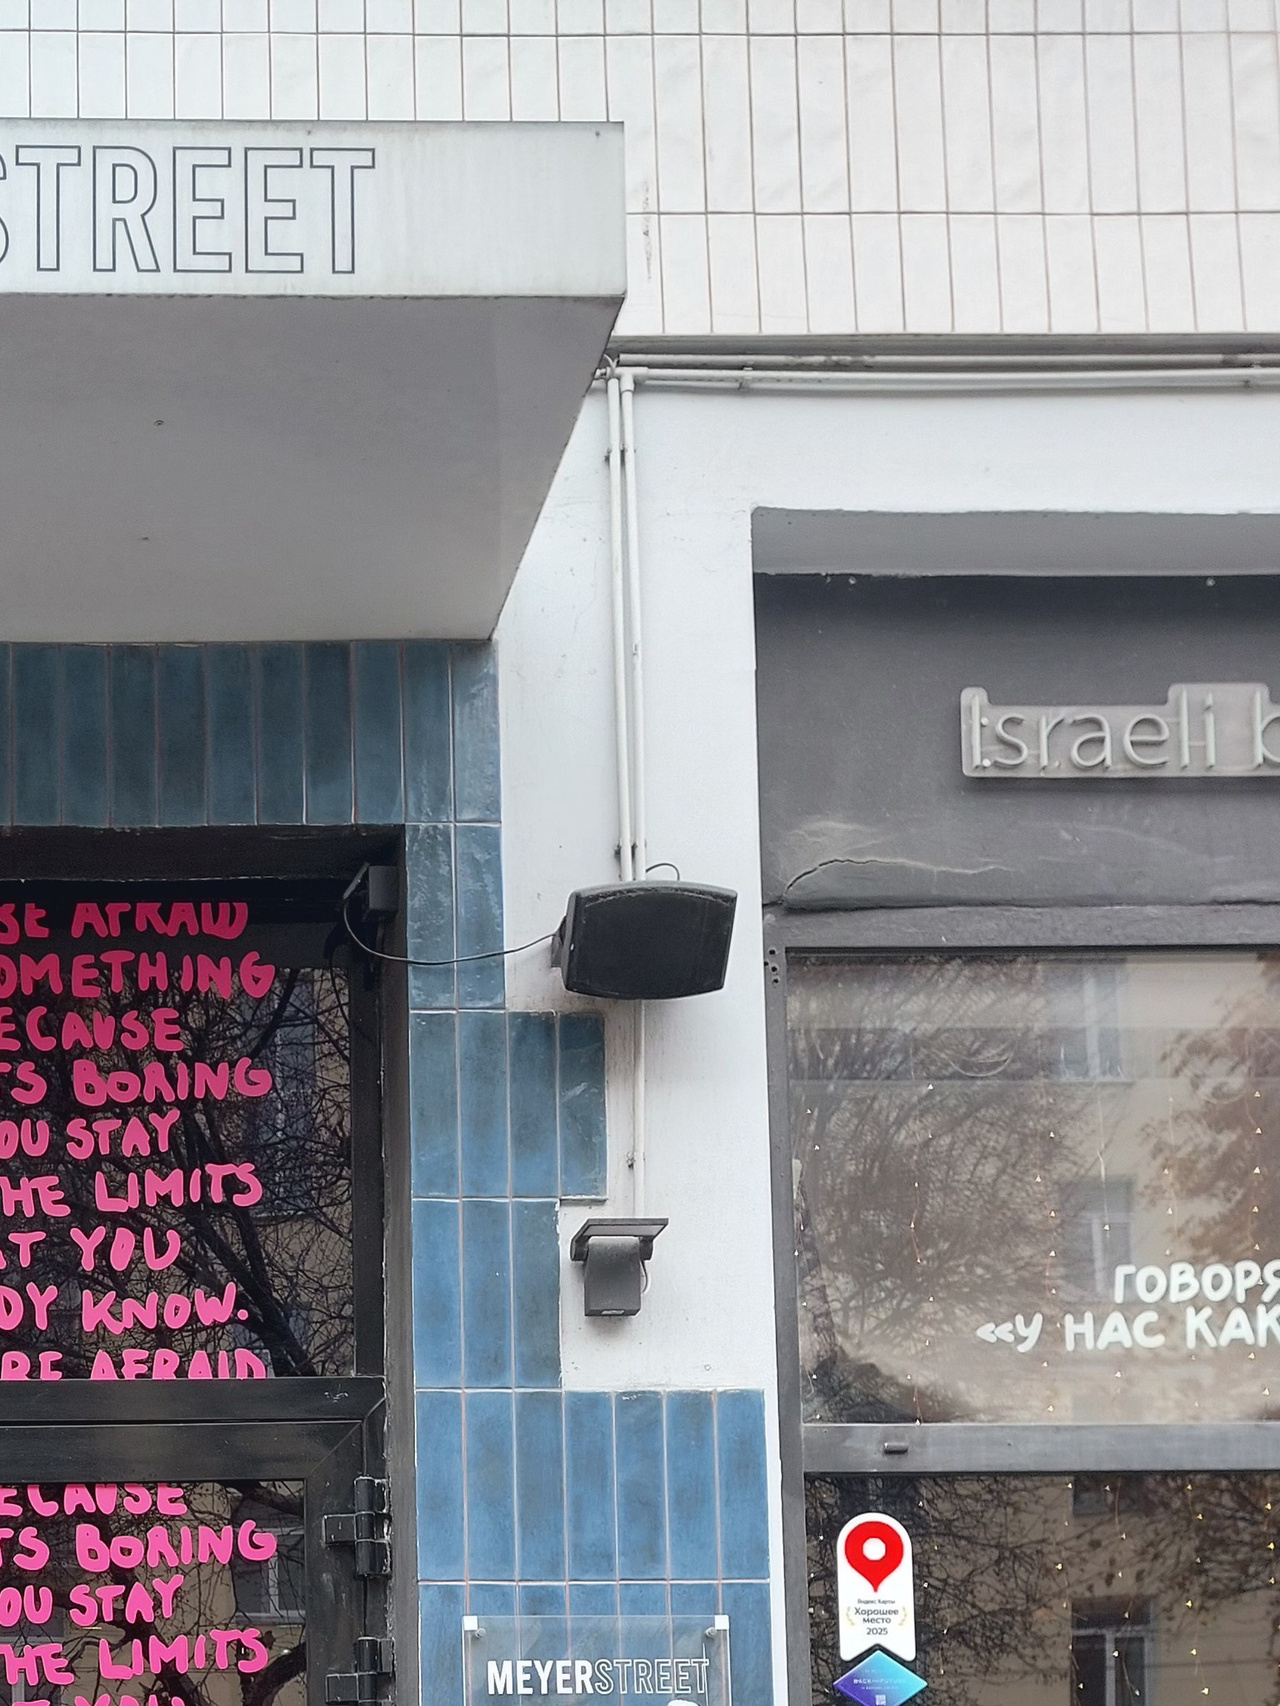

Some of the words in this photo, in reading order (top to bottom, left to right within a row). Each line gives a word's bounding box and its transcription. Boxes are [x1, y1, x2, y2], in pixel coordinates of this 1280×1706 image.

[970, 688, 1215, 770] Israeli
[72, 903, 247, 939] AFRAID
[74, 1057, 272, 1106] BORING
[67, 1109, 180, 1159] STAY
[95, 1163, 262, 1212] LIMITS
[71, 1226, 181, 1271] YOU
[1114, 1259, 1280, 1304] ГОВОРЯ
[82, 1283, 248, 1336] KNOW.
[1064, 1311, 1166, 1351] НАС
[1185, 1305, 1280, 1350] КАК
[76, 1520, 277, 1572] BORING
[70, 1575, 184, 1626] STAY
[854, 1607, 899, 1616] Хорошее
[99, 1629, 268, 1680] LIMITS
[866, 1627, 888, 1635] 2025
[487, 1658, 709, 1695] MEYERSTREET
